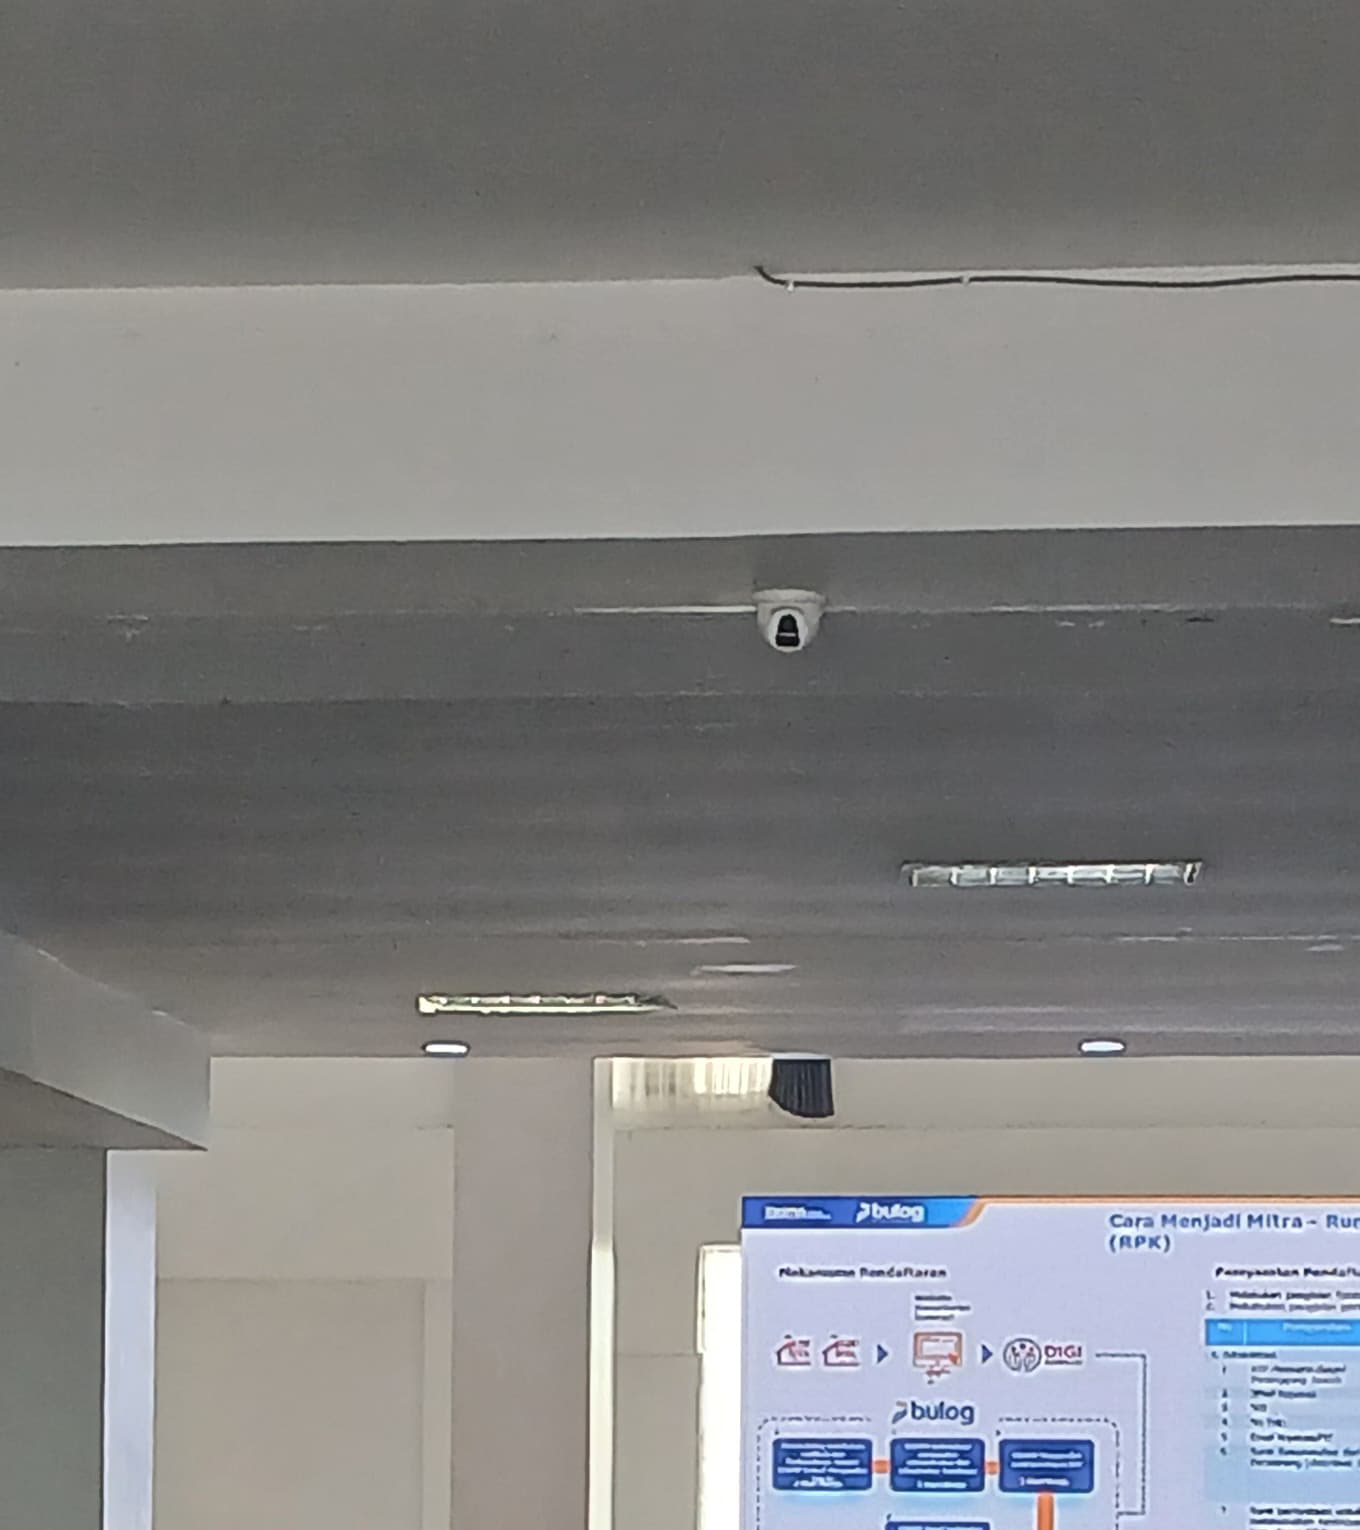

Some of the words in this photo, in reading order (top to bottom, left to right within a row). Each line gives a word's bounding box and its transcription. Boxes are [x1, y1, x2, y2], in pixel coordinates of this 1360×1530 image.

[872, 1202, 925, 1223] bulog
[1109, 1213, 1155, 1229] Cara
[1161, 1213, 1240, 1232] Menjadi
[1247, 1213, 1303, 1229] Mitra
[1109, 1234, 1171, 1253] (RPK)
[910, 1401, 975, 1425] bulog
